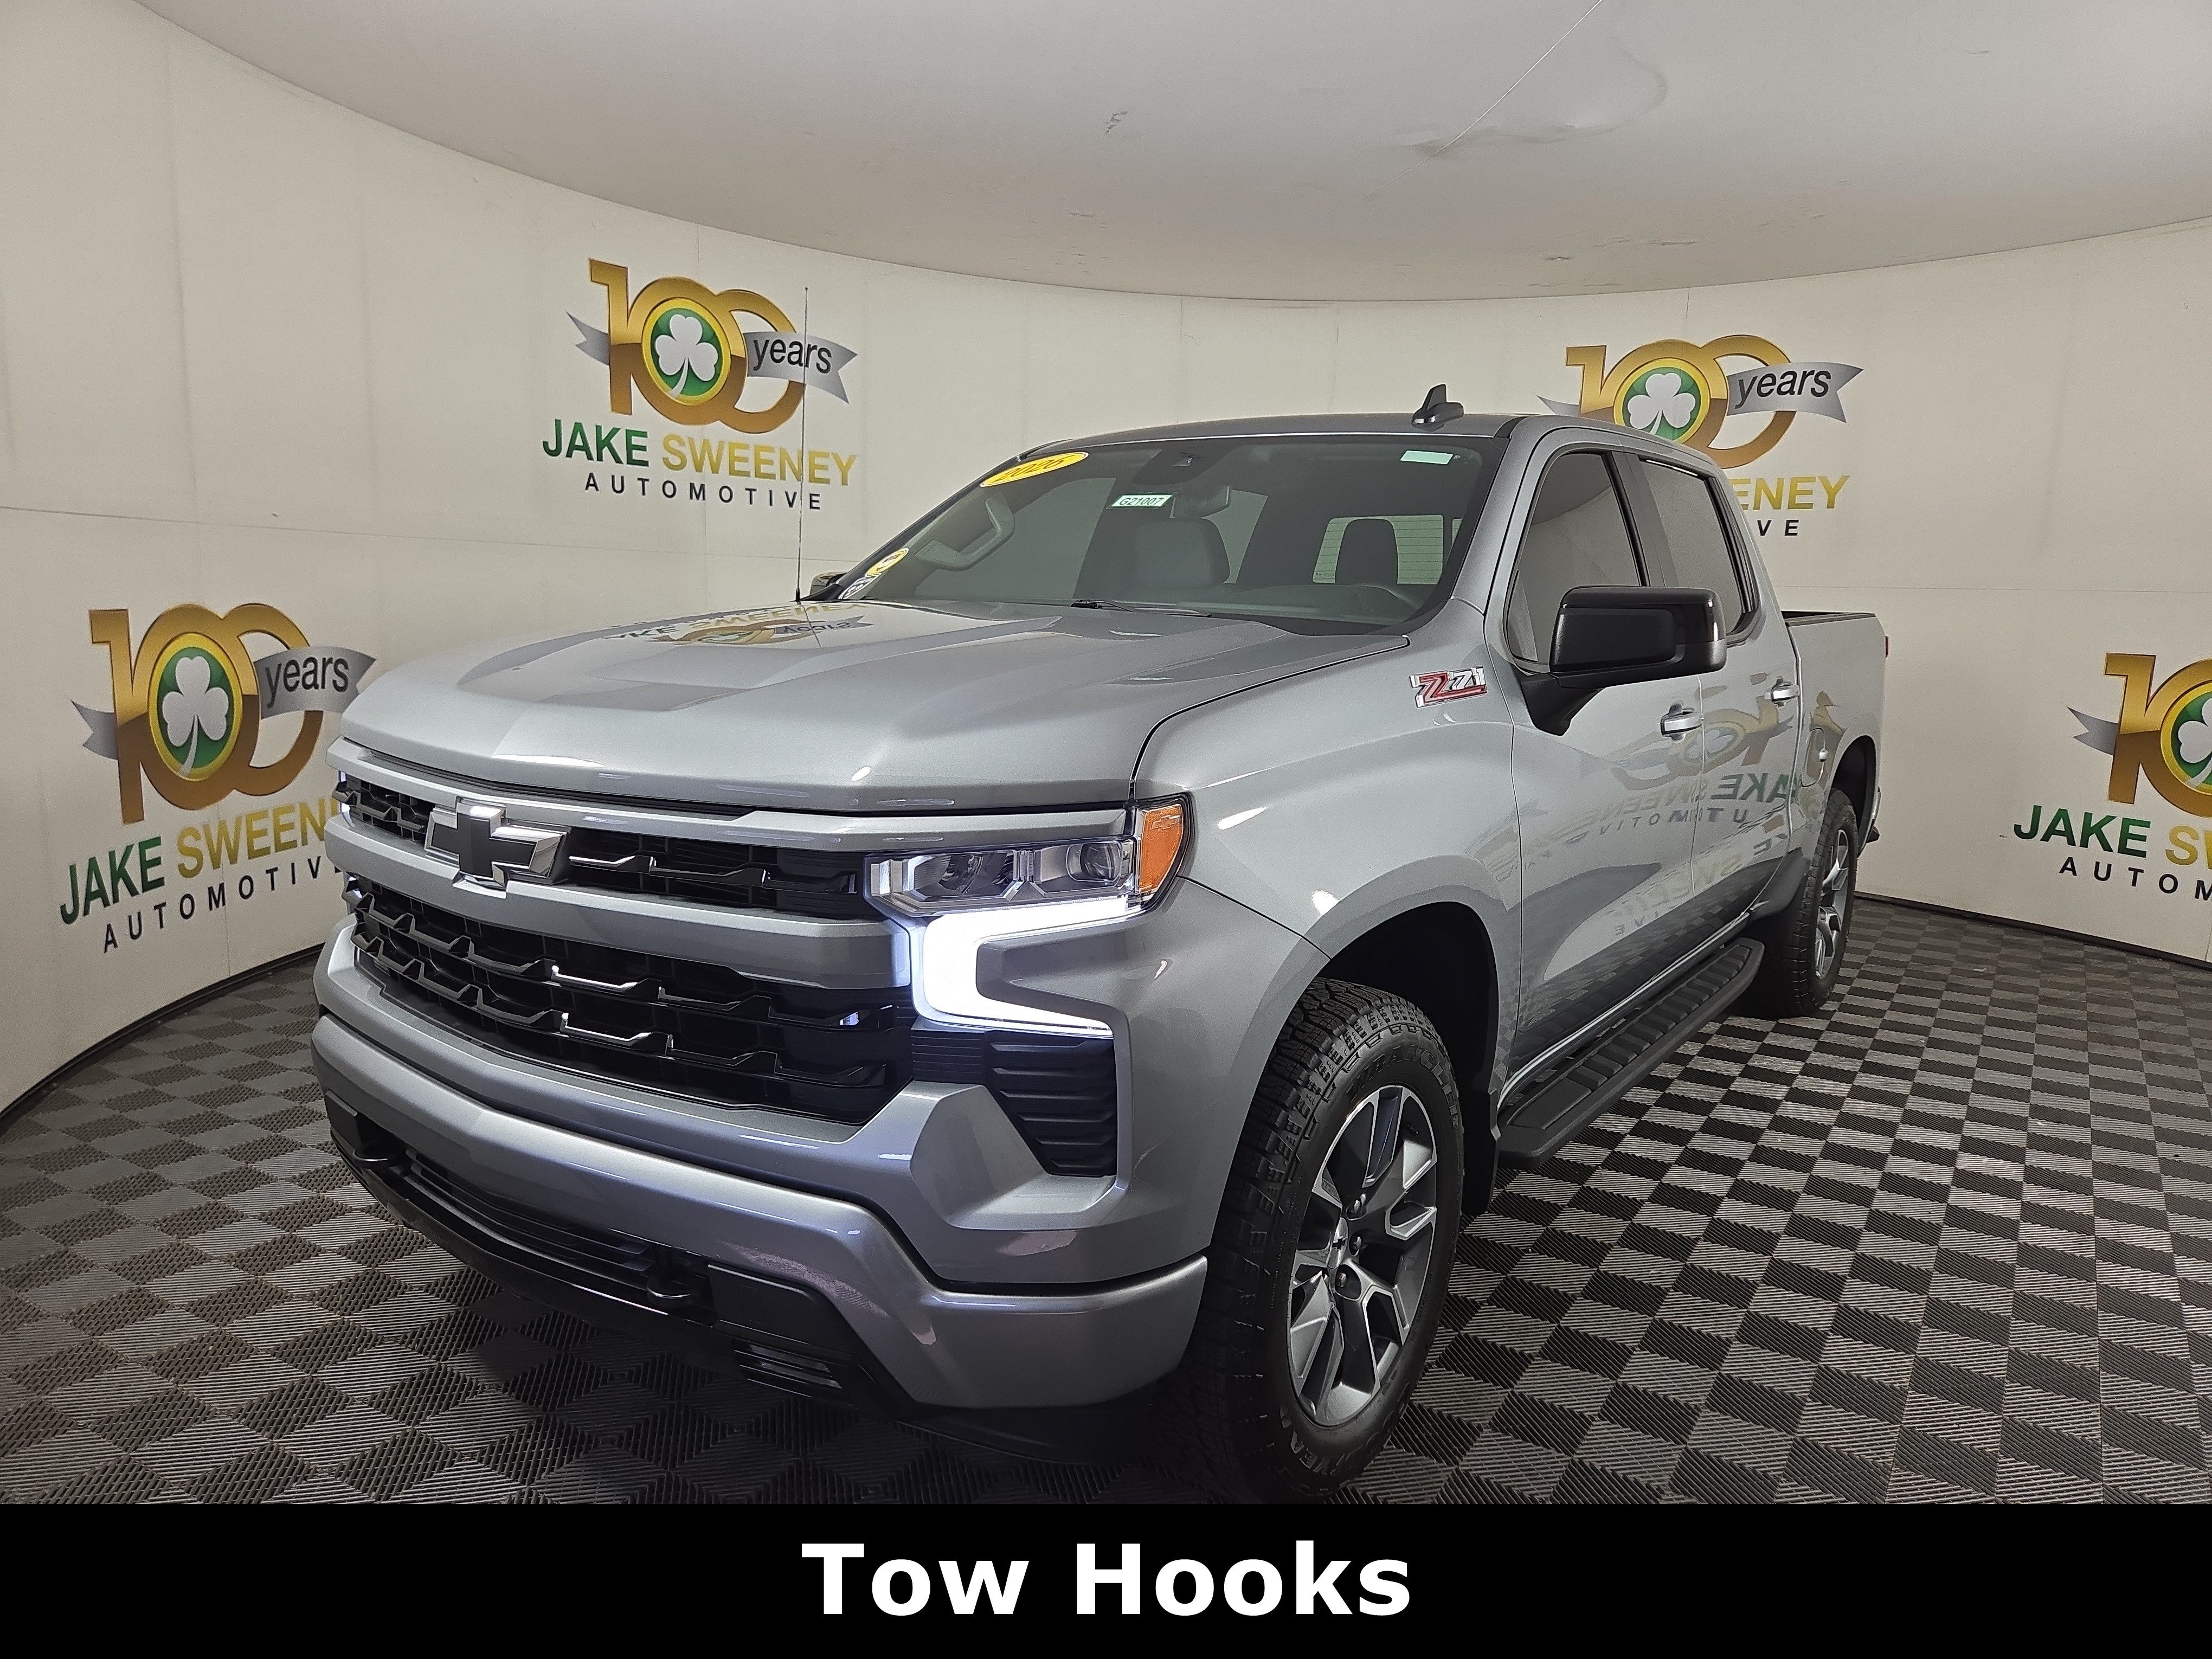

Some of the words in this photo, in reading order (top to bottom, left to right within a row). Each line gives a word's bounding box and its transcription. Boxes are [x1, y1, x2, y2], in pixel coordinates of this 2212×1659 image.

[589, 258, 807, 434] 100
[753, 338, 832, 374] years
[1735, 369, 1831, 409] years
[543, 419, 650, 467] JAKE
[662, 434, 857, 486] SWEENEY
[585, 473, 821, 510] AUTOMOTIVE
[1119, 497, 1166, 505] G21007
[88, 603, 324, 824] 100
[265, 655, 349, 709] years
[1410, 665, 1488, 708] Z71
[2014, 805, 2151, 858] JAKE
[2165, 825, 2212, 870] S
[60, 837, 165, 924] JAKE
[104, 856, 342, 954] AUTOMOTIV
